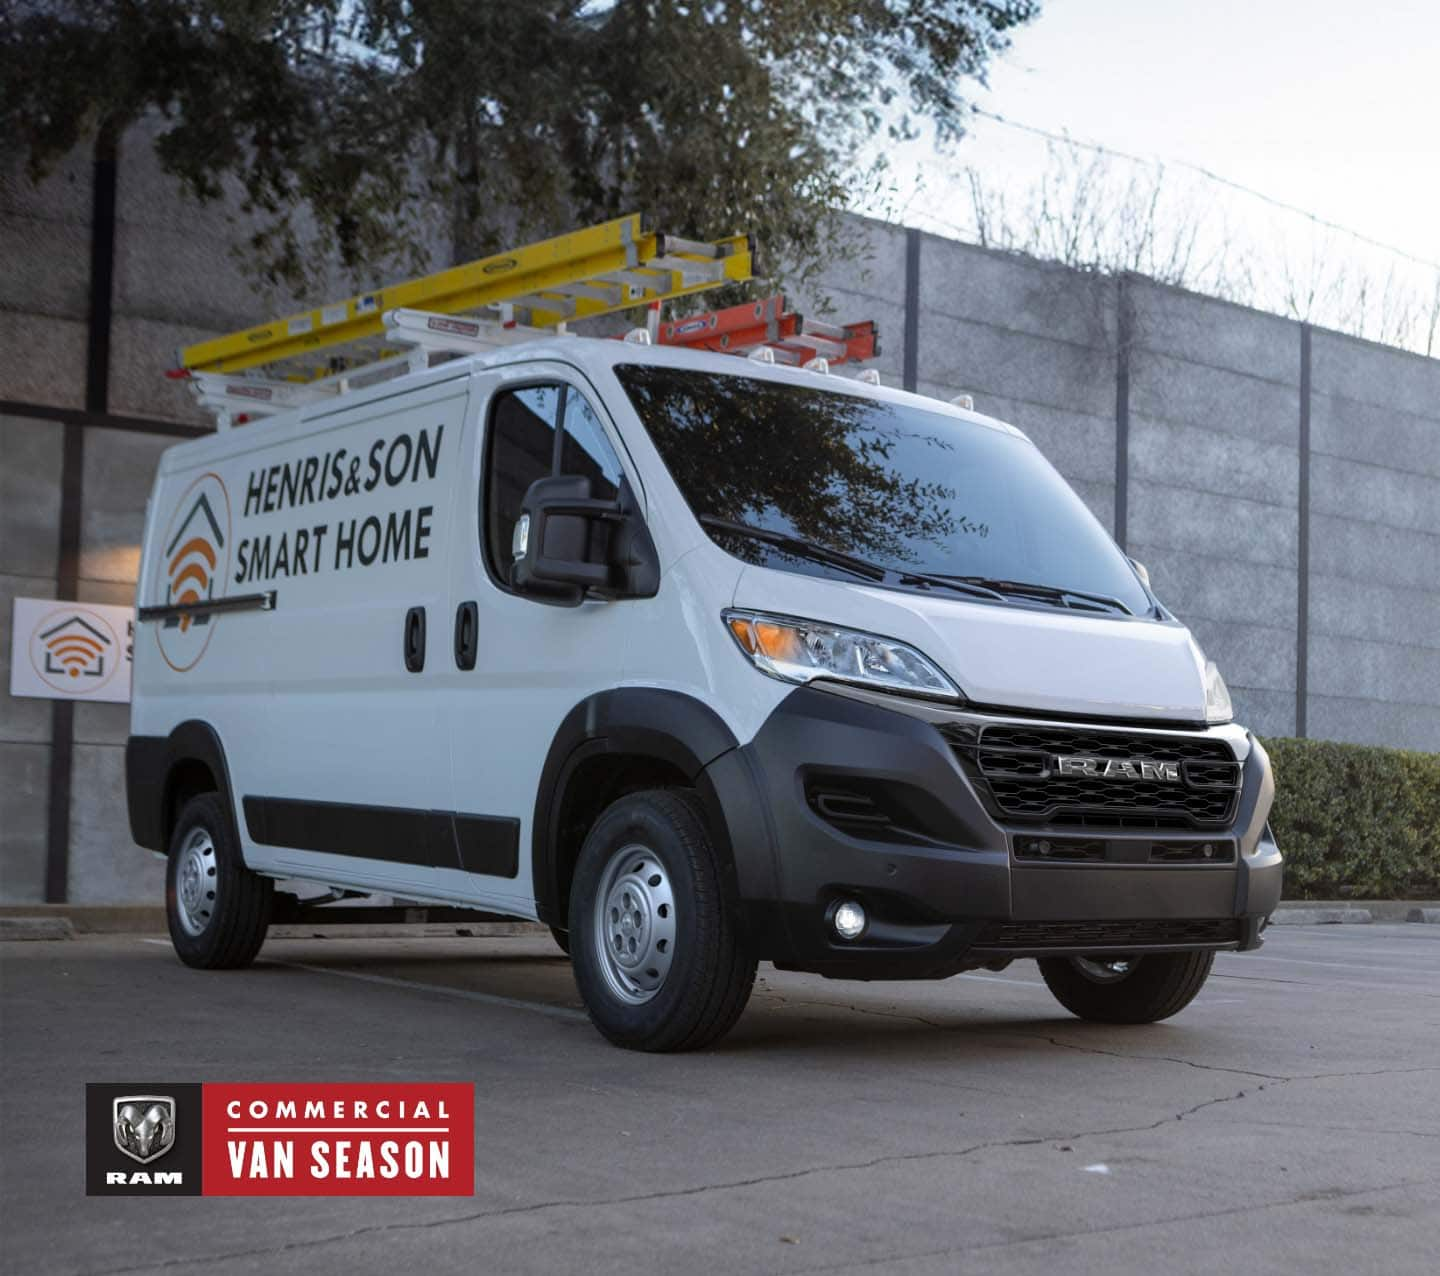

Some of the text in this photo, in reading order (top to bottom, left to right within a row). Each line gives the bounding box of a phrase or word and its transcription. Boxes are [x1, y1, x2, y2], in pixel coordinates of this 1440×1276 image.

[243, 424, 444, 517] HENRIS&SON
[234, 505, 434, 584] SMART HOME
[1057, 755, 1179, 781] RAM
